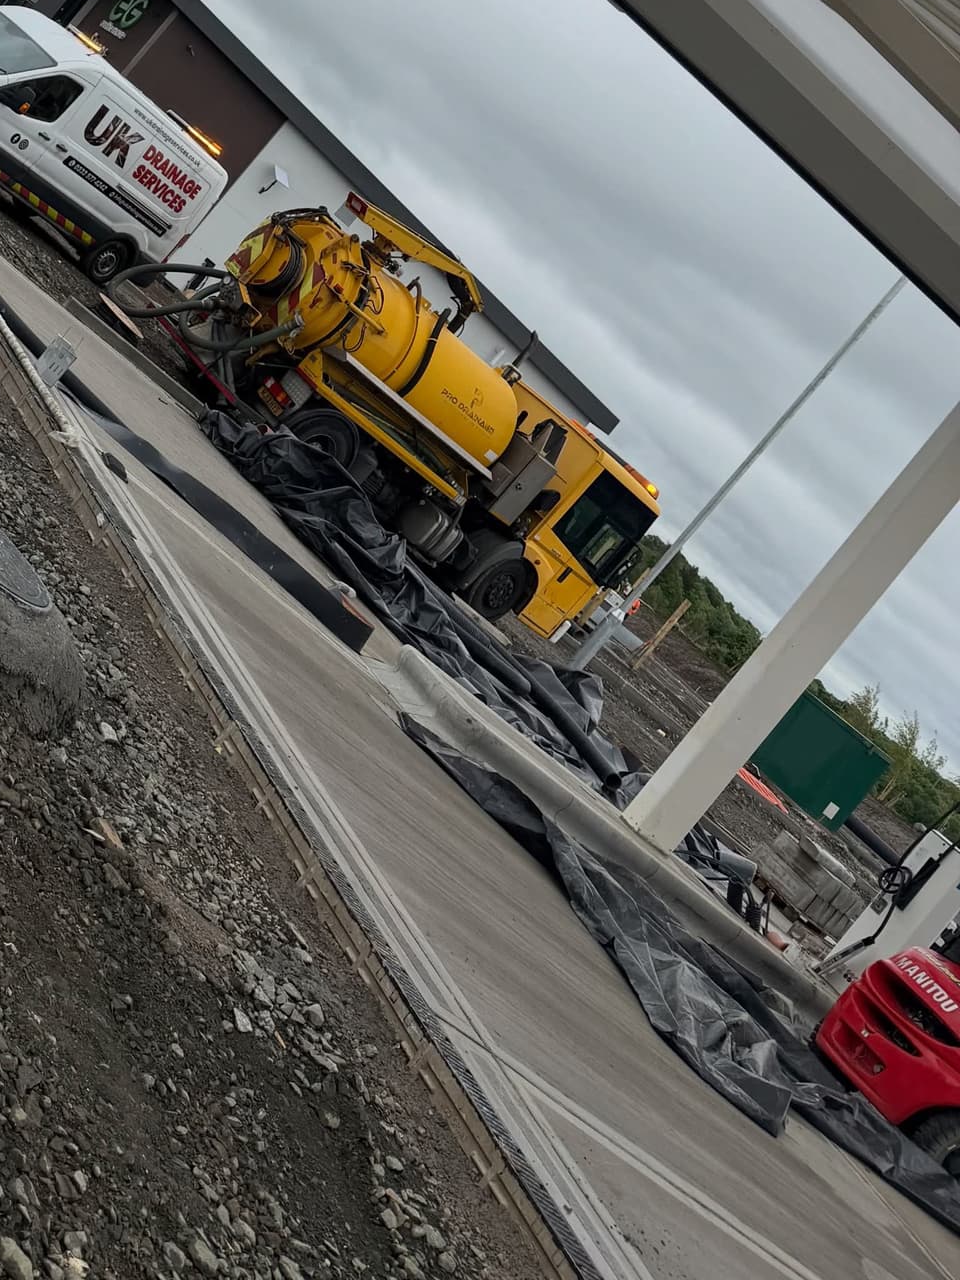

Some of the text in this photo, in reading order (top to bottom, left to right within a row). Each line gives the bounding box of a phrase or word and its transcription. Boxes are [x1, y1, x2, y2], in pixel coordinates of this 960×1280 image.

[84, 104, 145, 169] UK
[132, 164, 187, 214] SERVICES
[142, 144, 202, 200] DRAINAGE
[441, 388, 458, 405] PRO
[895, 956, 959, 1013] MANITOU
